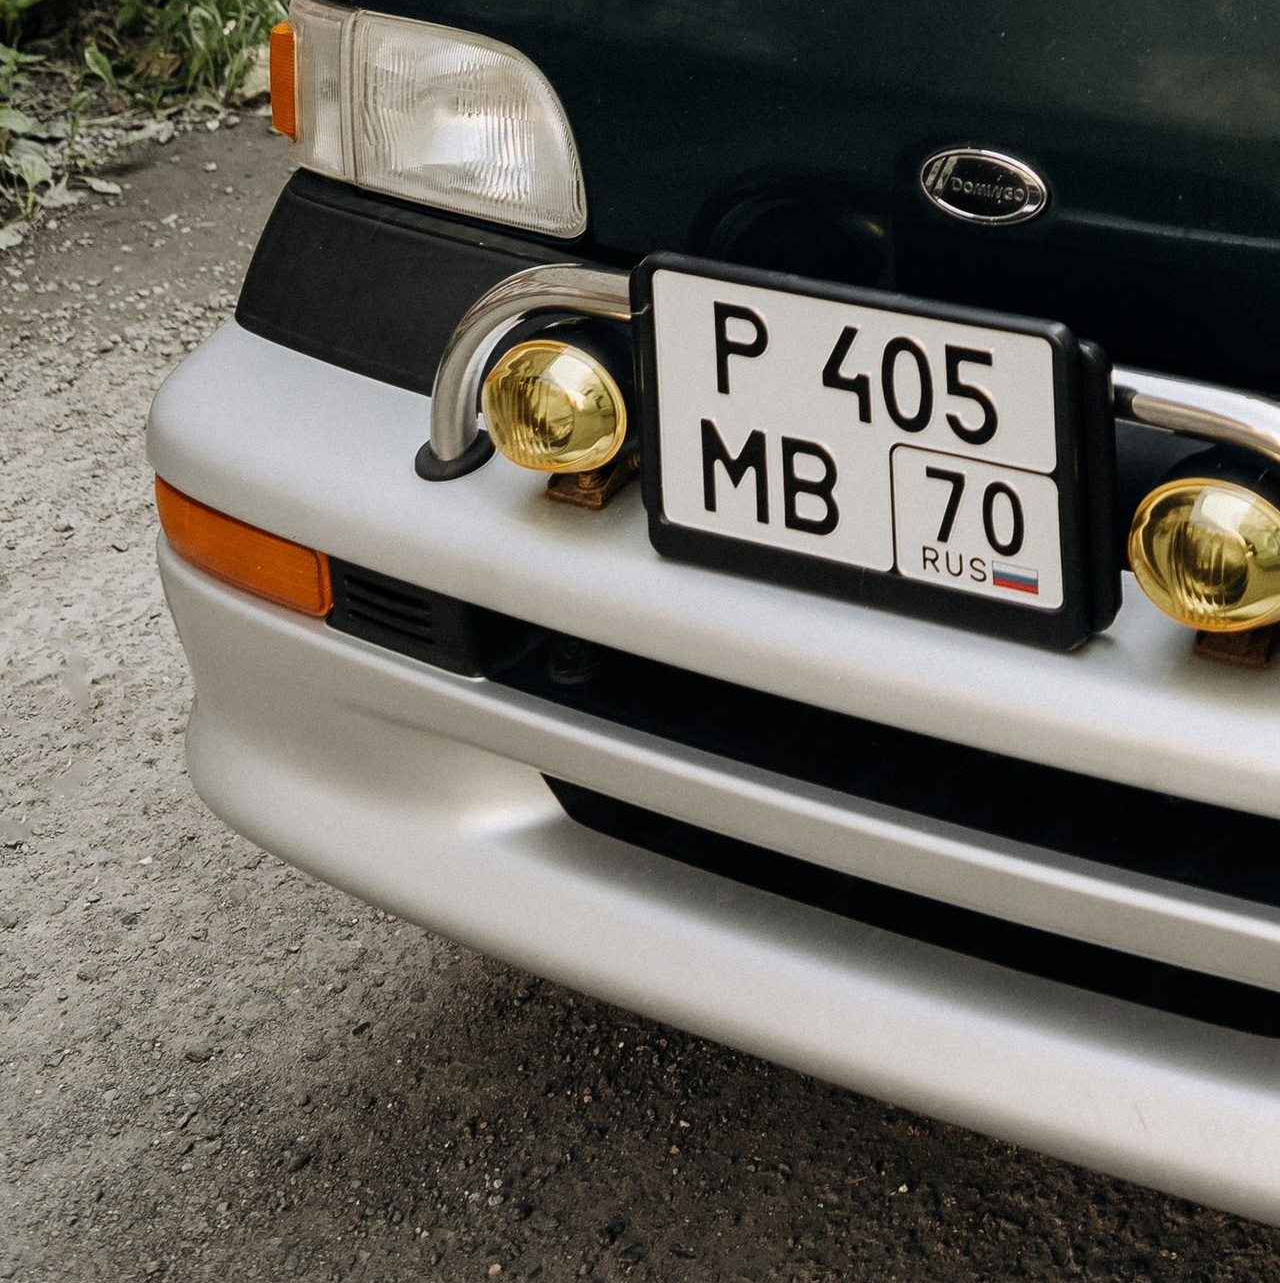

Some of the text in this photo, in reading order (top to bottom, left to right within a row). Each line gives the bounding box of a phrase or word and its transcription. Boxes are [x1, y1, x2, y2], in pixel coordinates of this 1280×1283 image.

[951, 177, 1025, 202] DOMINGO
[822, 326, 999, 446] 405
[925, 466, 1025, 558] 70
[922, 546, 988, 583] RUS
